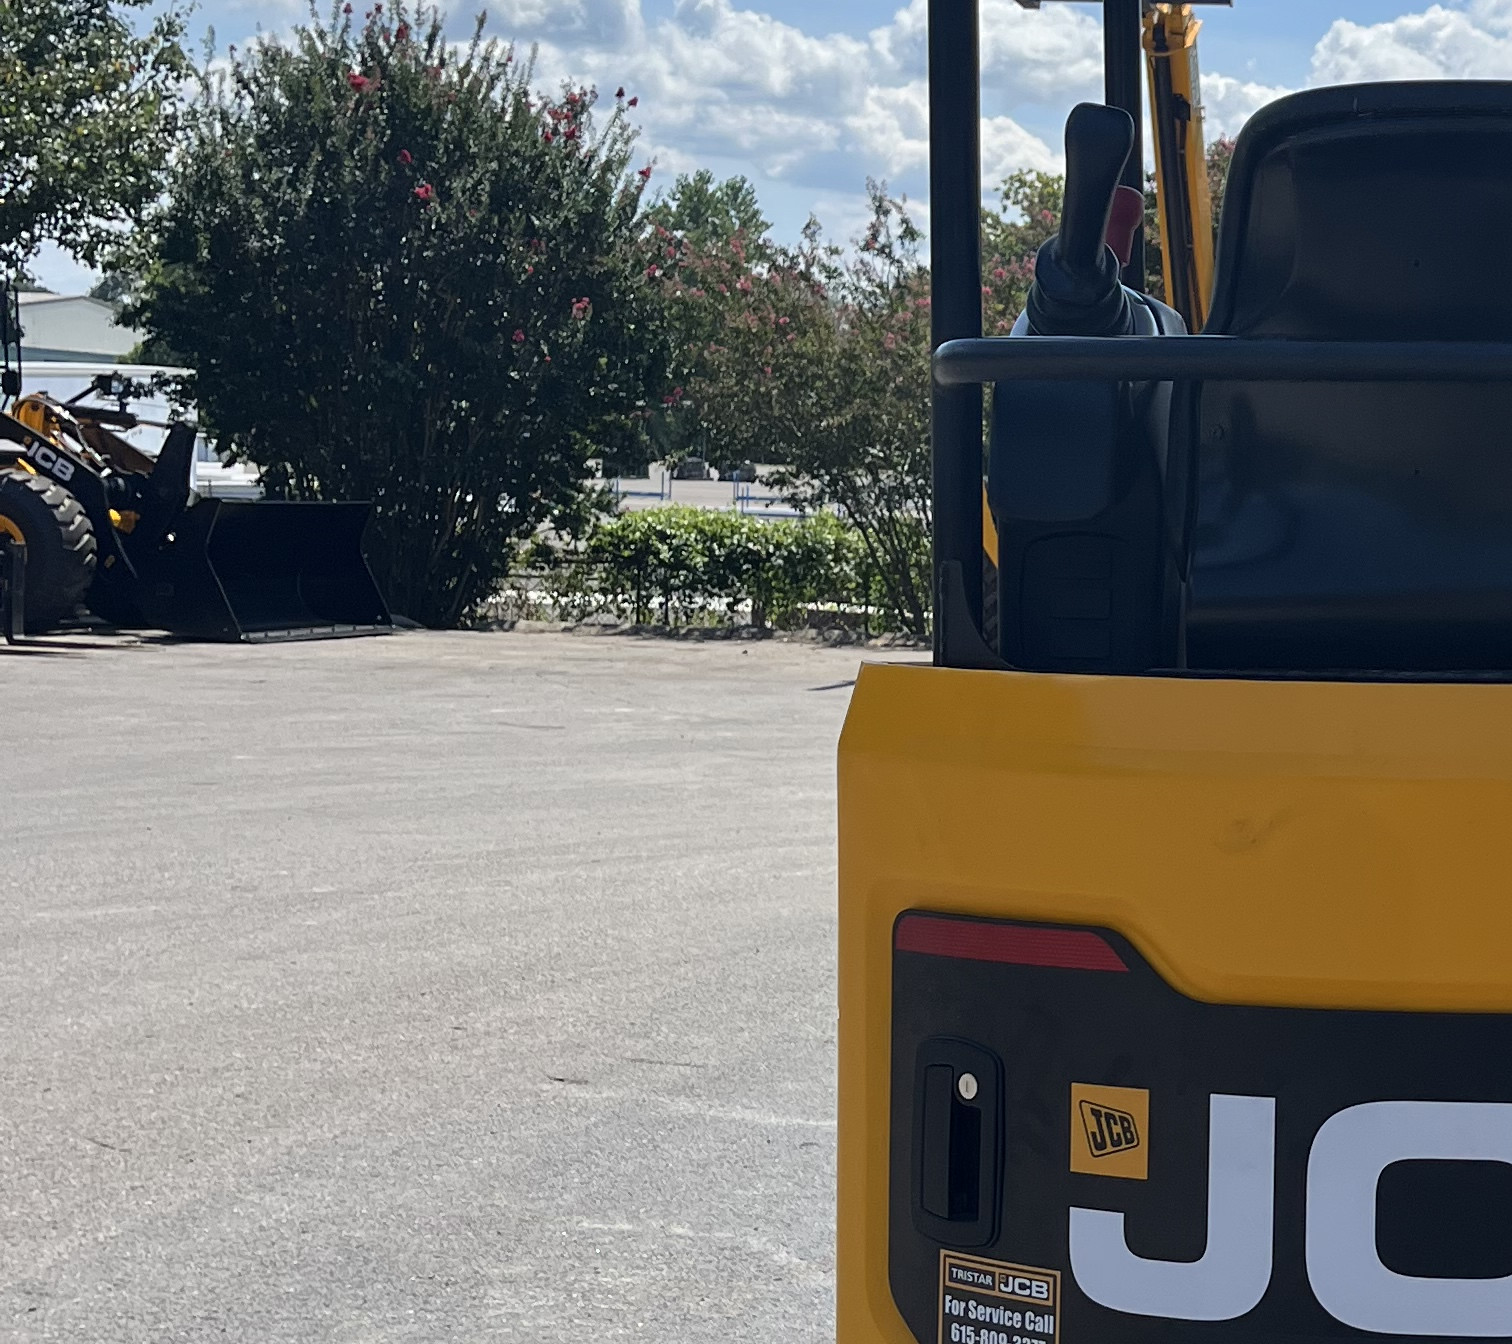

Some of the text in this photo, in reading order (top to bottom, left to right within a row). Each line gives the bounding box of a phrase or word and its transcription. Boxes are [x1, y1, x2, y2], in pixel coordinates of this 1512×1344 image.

[27, 440, 76, 482] JCB
[1089, 1107, 1136, 1152] JCB
[950, 1267, 1049, 1299] TRISTAR JCB
[944, 1294, 1055, 1335] For Service Call
